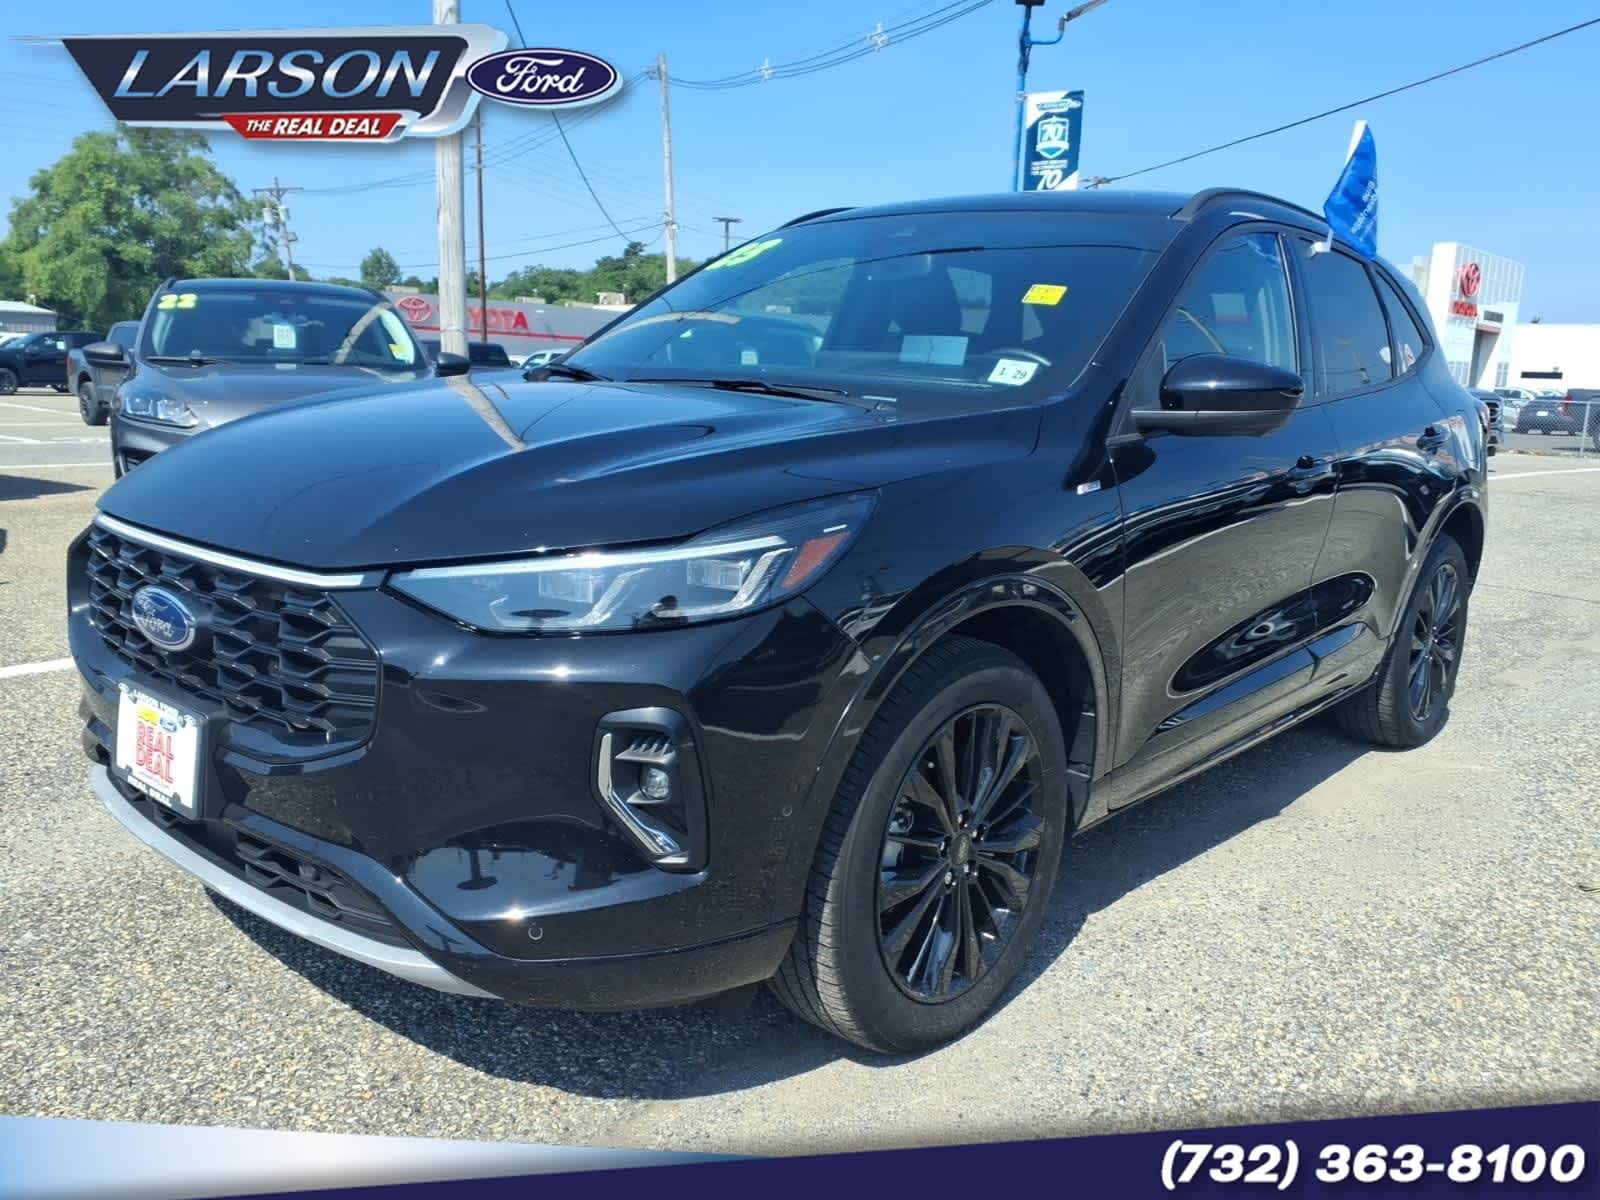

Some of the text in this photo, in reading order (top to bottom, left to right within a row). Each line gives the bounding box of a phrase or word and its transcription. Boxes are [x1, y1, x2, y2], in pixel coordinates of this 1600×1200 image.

[158, 294, 198, 310] 22
[136, 592, 175, 638] Ford
[136, 720, 175, 760] REAL
[136, 744, 174, 784] DEAL
